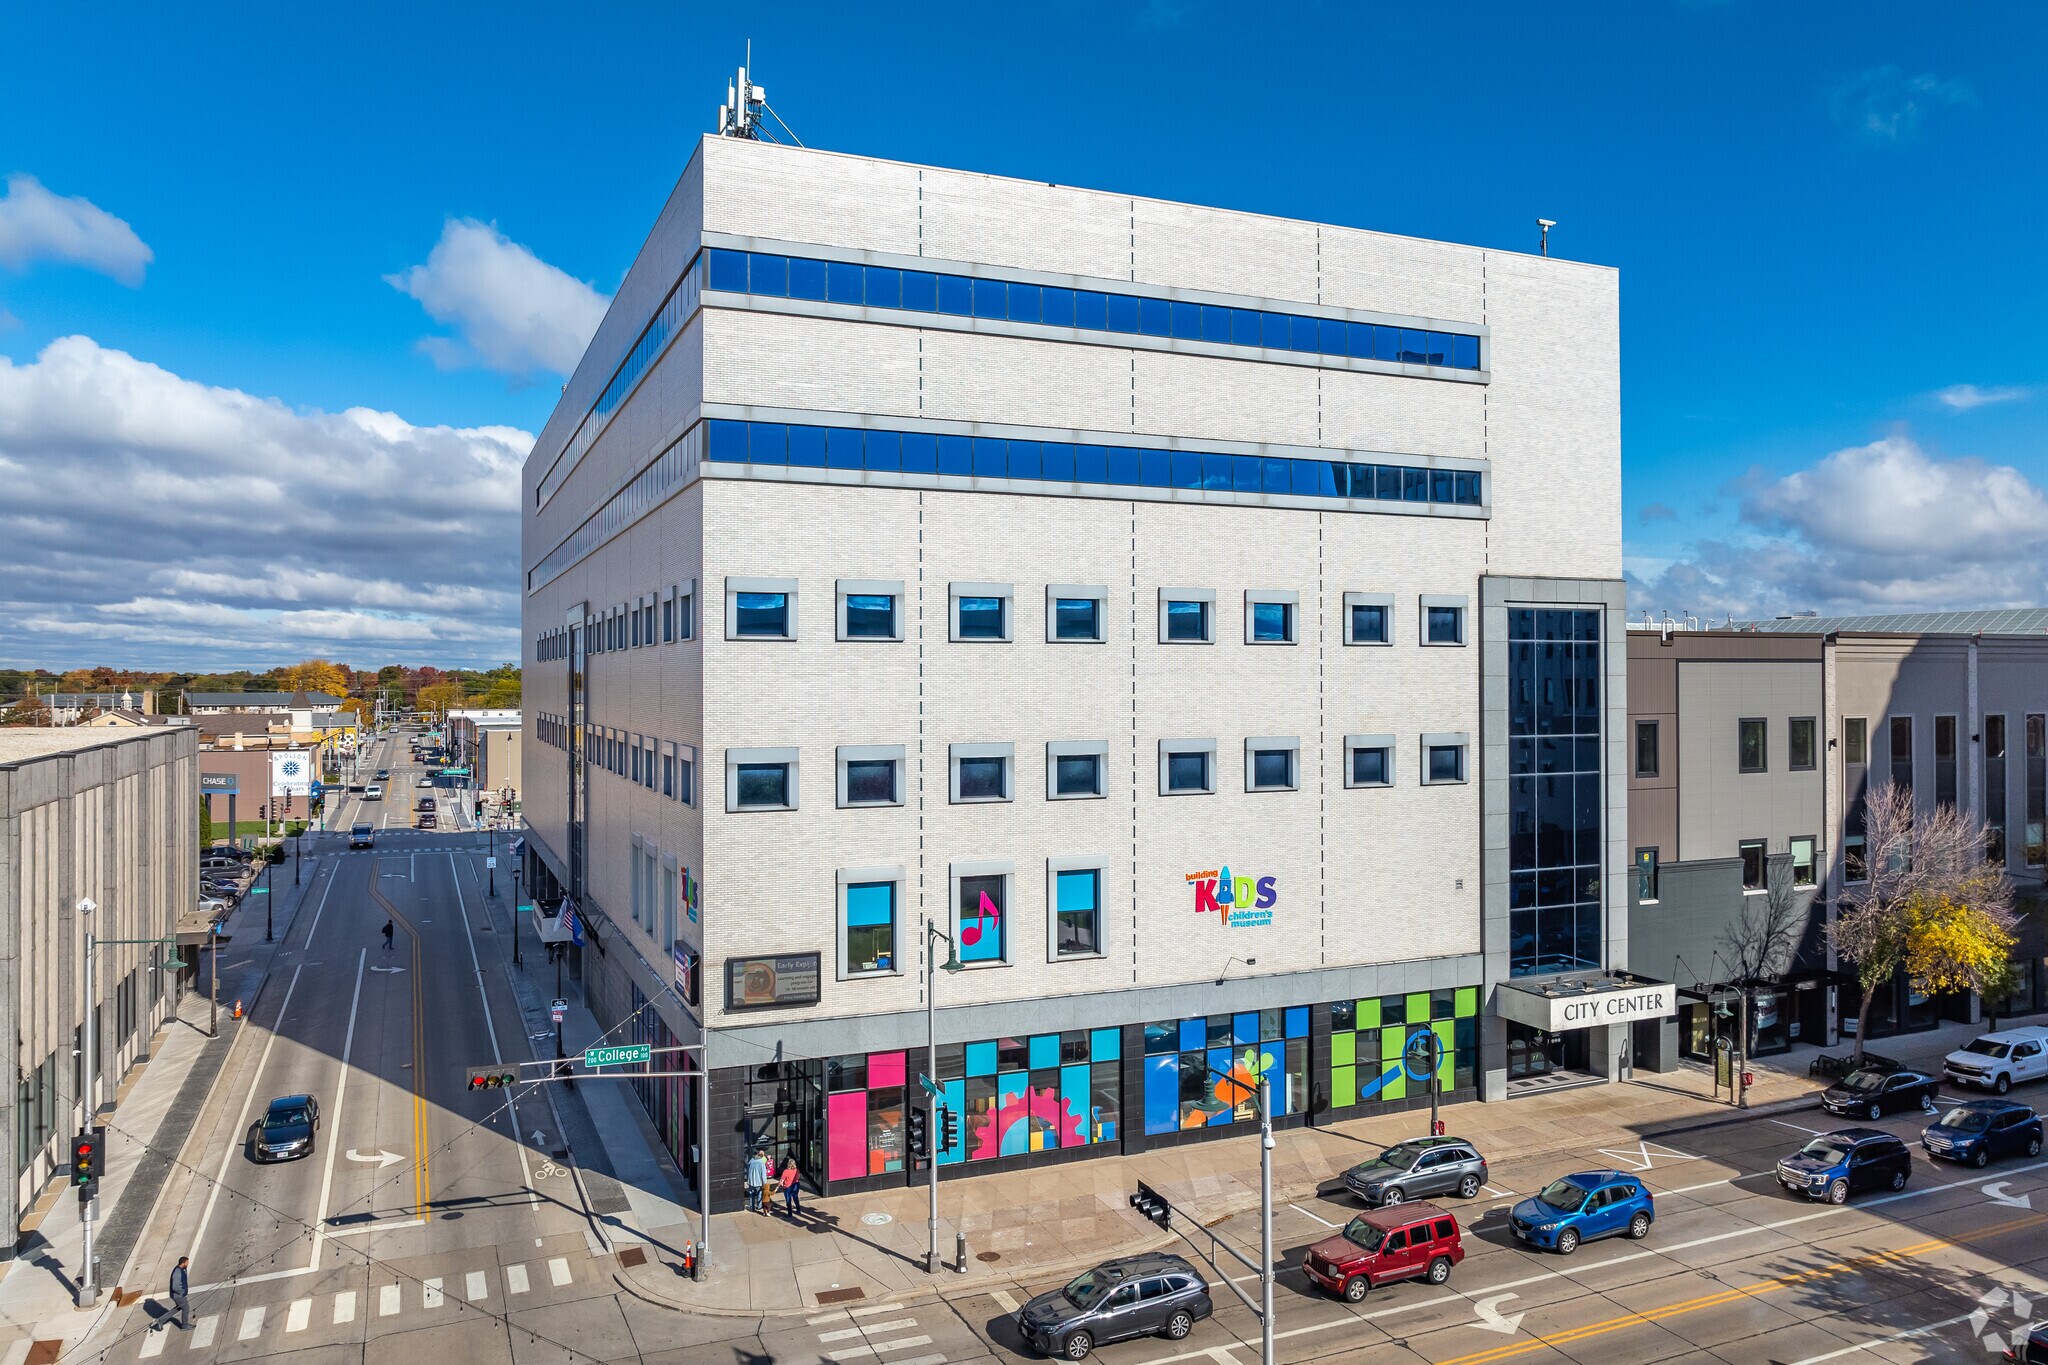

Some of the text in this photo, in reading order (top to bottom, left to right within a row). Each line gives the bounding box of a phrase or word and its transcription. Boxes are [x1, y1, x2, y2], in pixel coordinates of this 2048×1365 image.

[203, 777, 226, 785] CHASE
[1186, 870, 1218, 881] building
[1228, 910, 1273, 921] children's
[1231, 918, 1272, 928] museum
[777, 961, 794, 969] Early
[1564, 993, 1663, 1021] CITY CENTER
[598, 1049, 639, 1062] College
